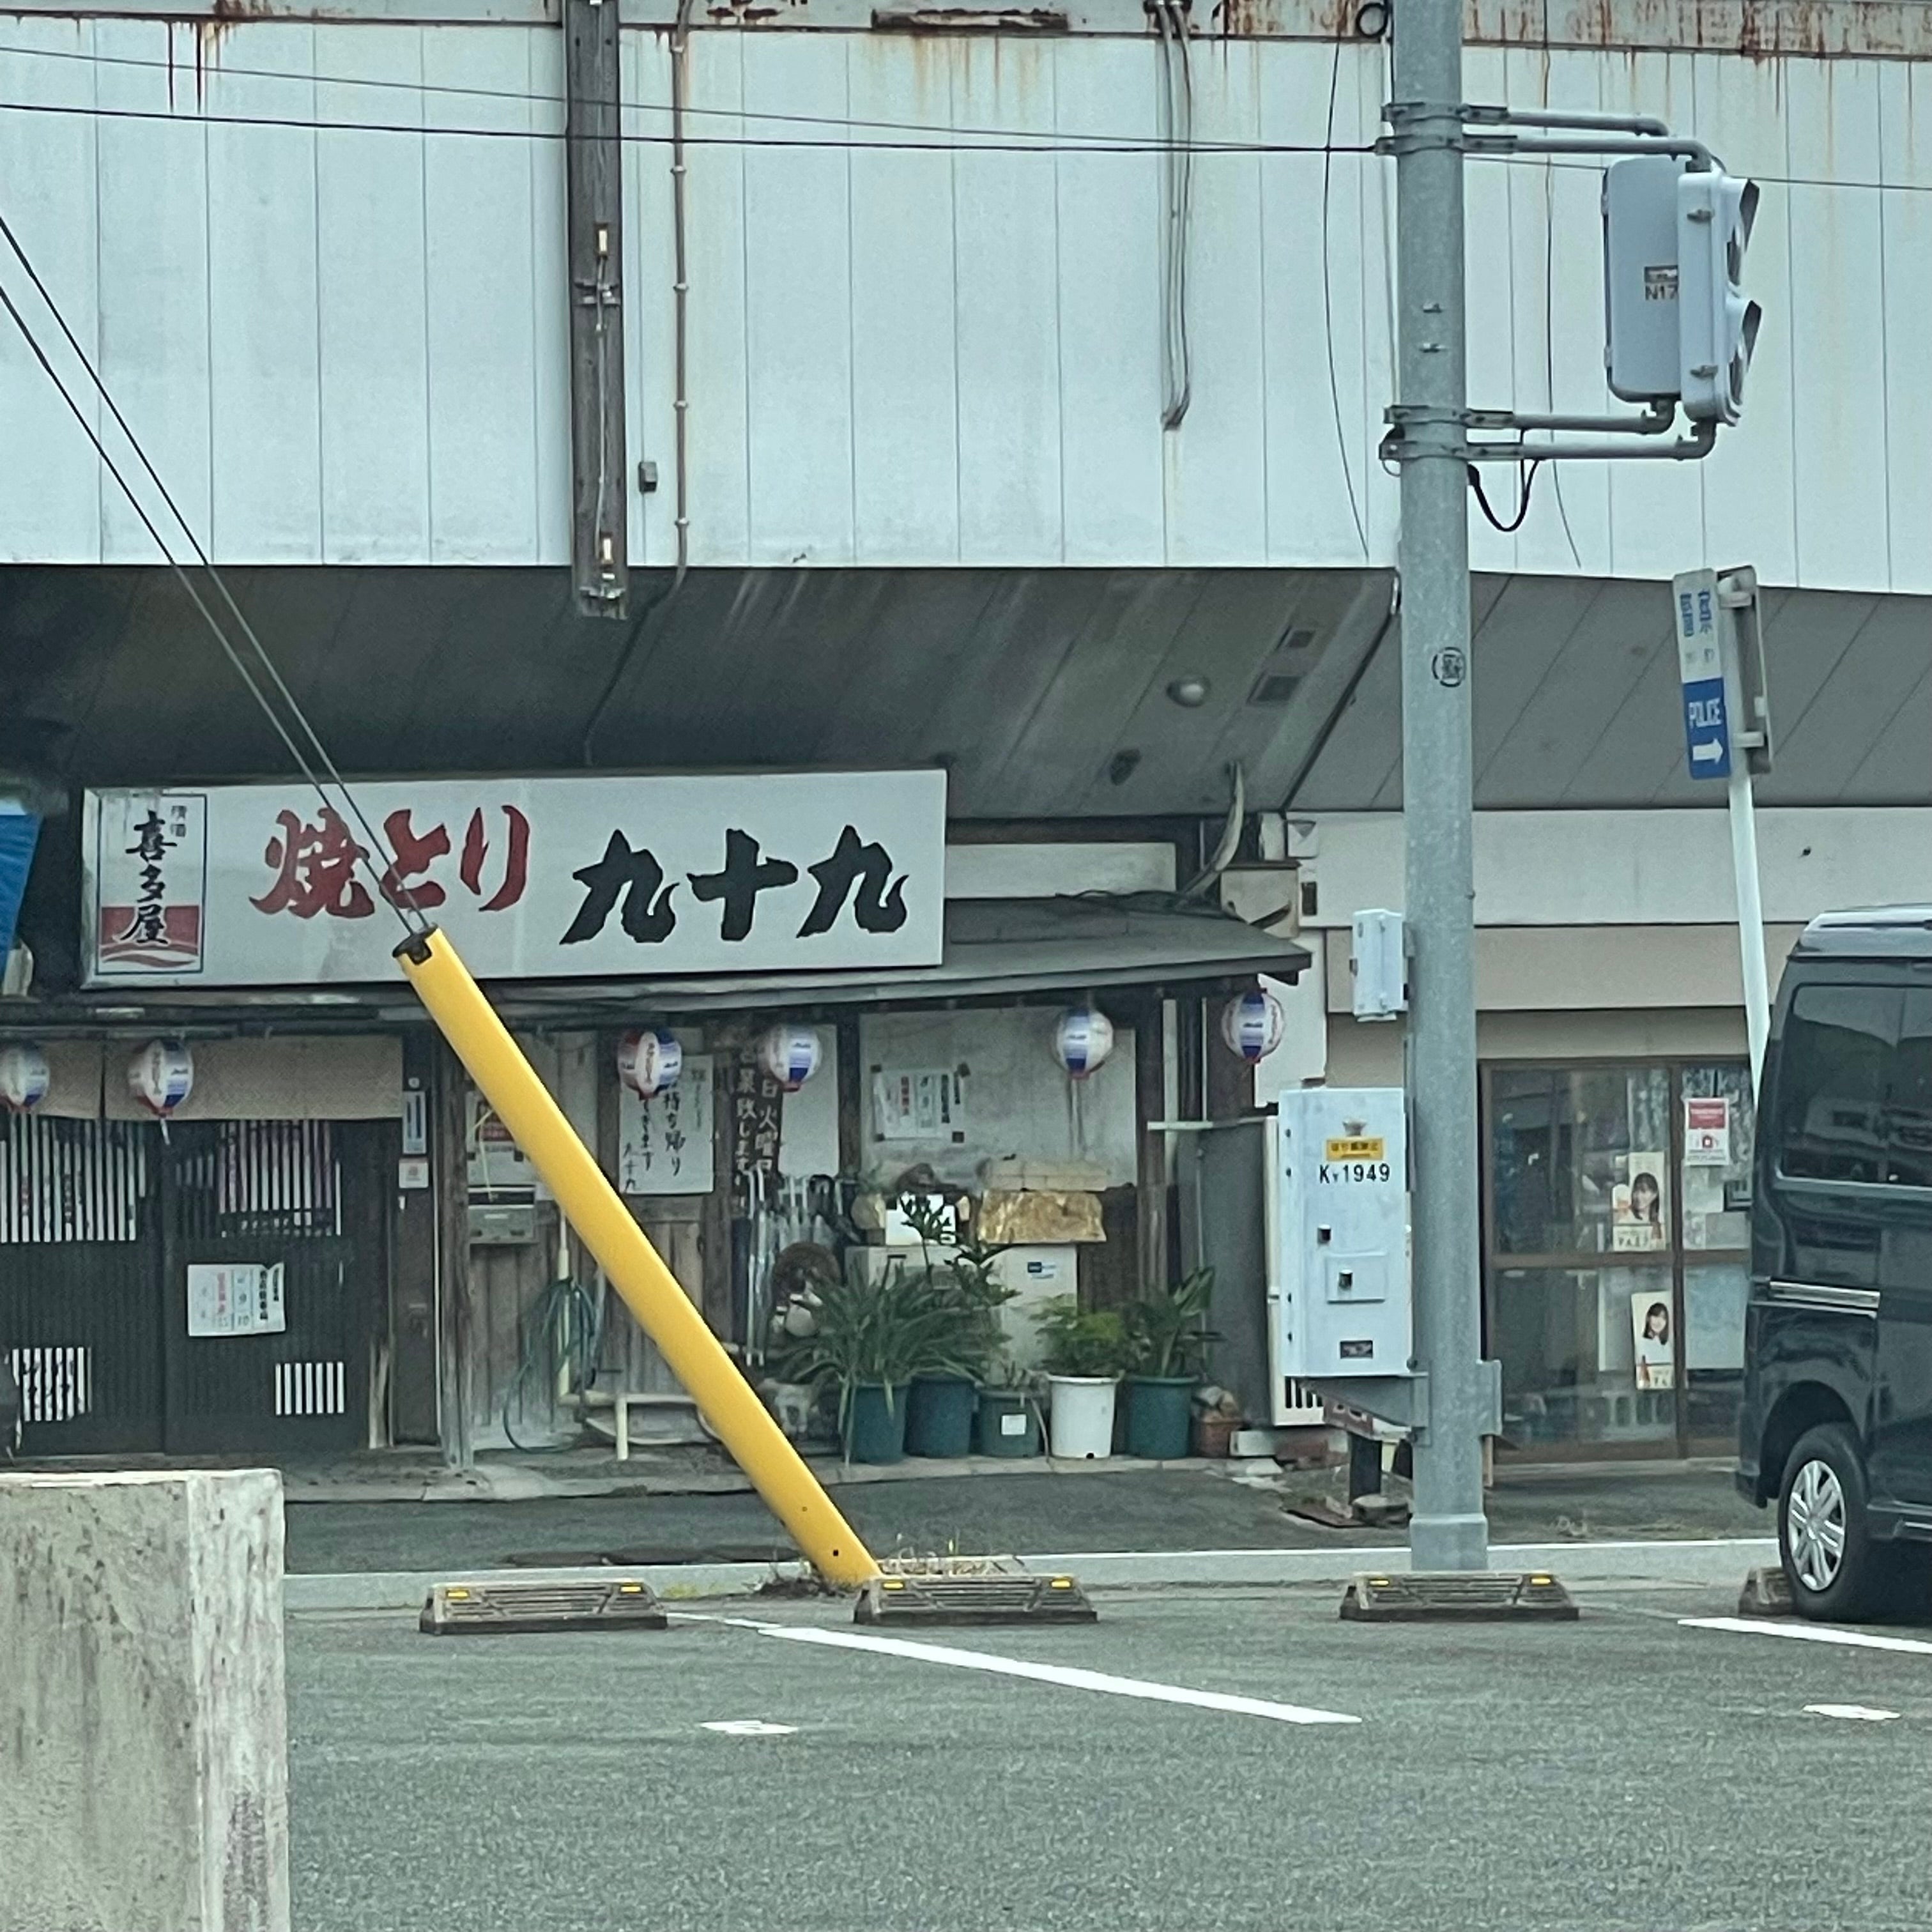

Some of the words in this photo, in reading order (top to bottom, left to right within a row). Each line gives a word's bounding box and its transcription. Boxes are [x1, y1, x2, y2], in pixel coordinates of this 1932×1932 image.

[119, 809, 178, 944] 喜多屋
[248, 804, 530, 919] 焼とり
[559, 824, 909, 945] 九十九
